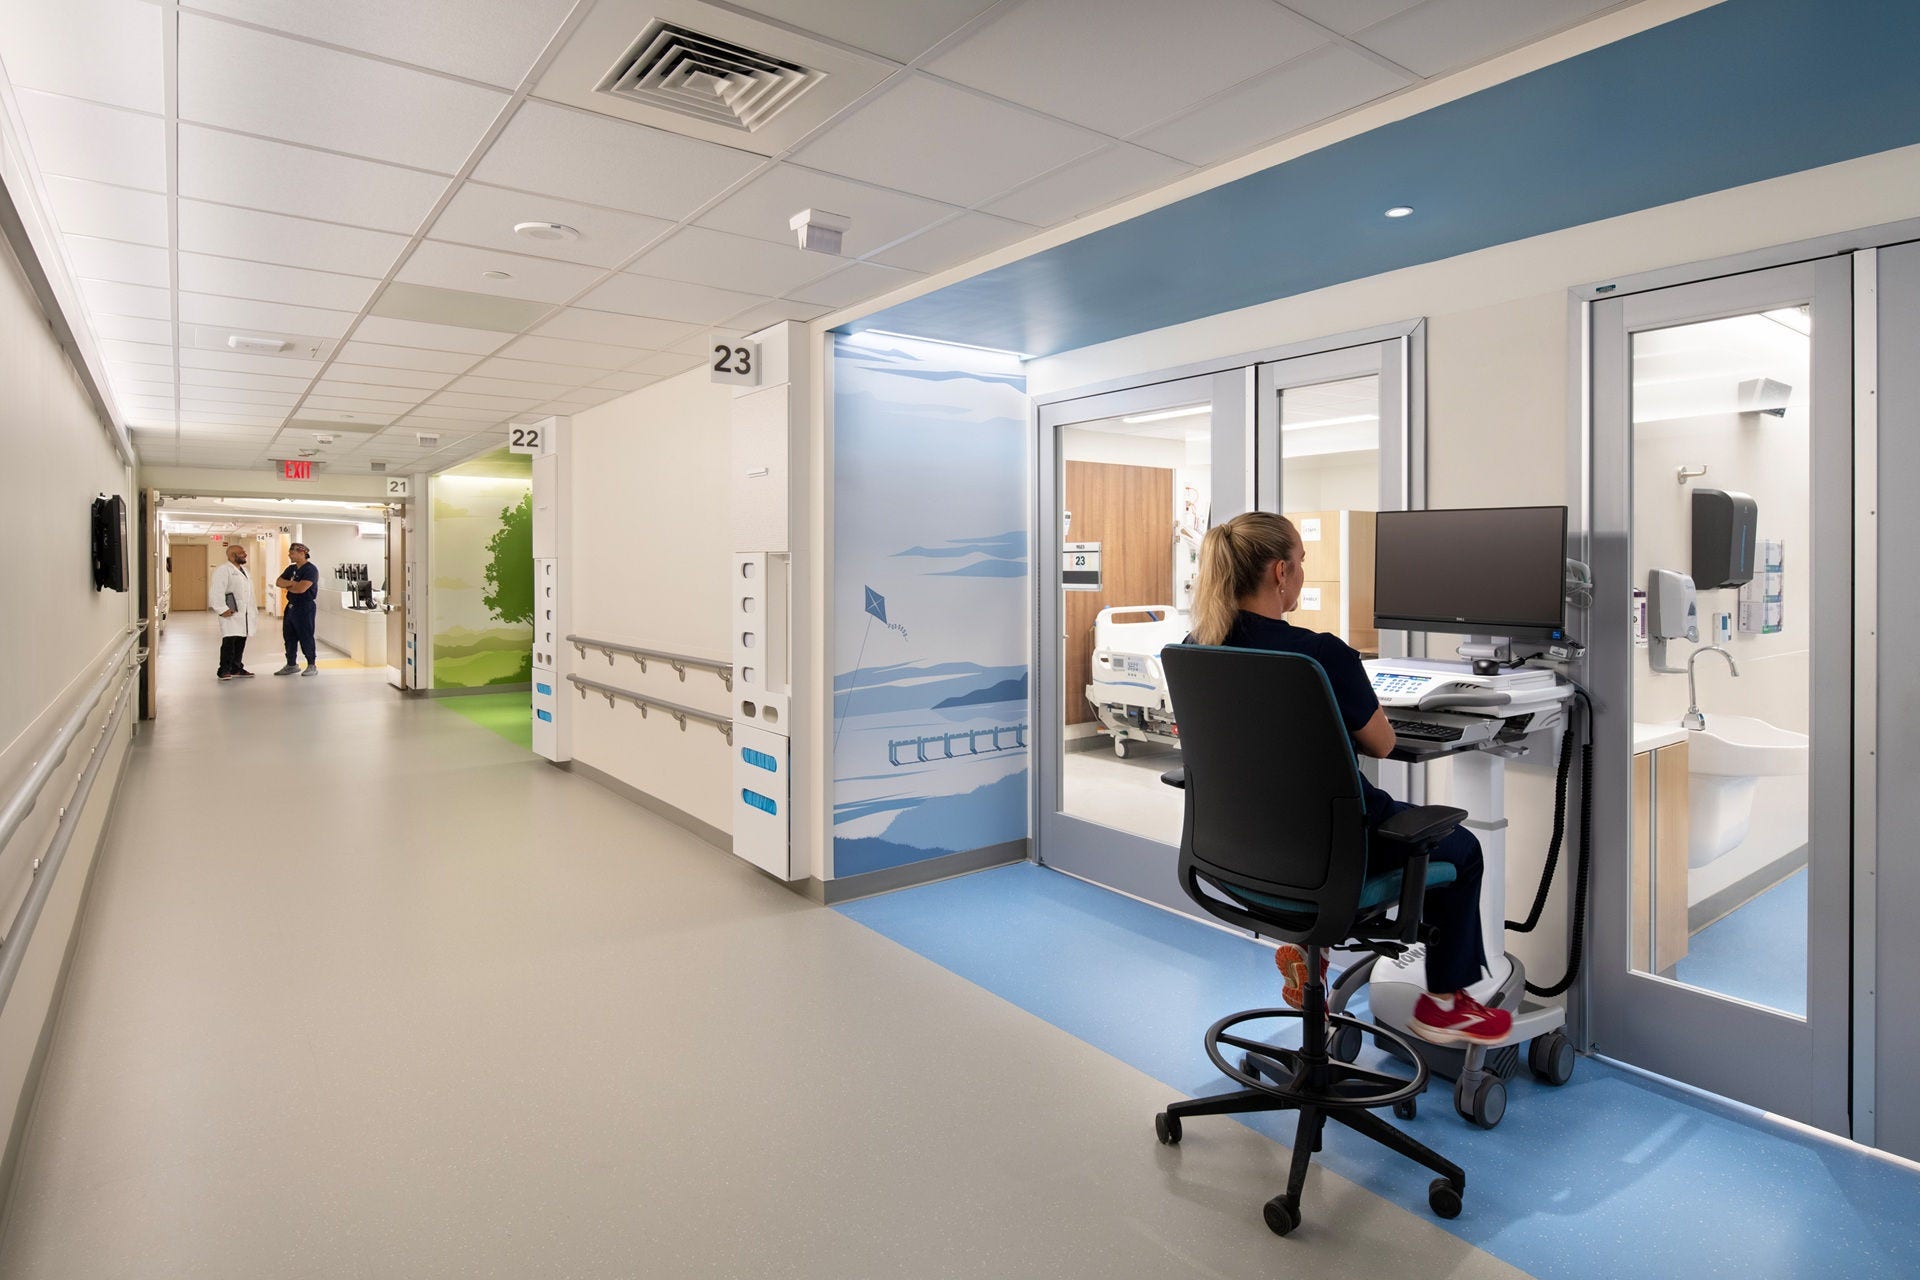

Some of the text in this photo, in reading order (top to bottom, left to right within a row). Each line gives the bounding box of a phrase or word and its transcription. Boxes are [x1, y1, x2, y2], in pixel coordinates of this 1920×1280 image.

[713, 344, 751, 375] 23
[512, 429, 539, 448] 22
[285, 461, 312, 479] EXIT
[390, 481, 406, 492] 21
[1075, 555, 1086, 566] 23
